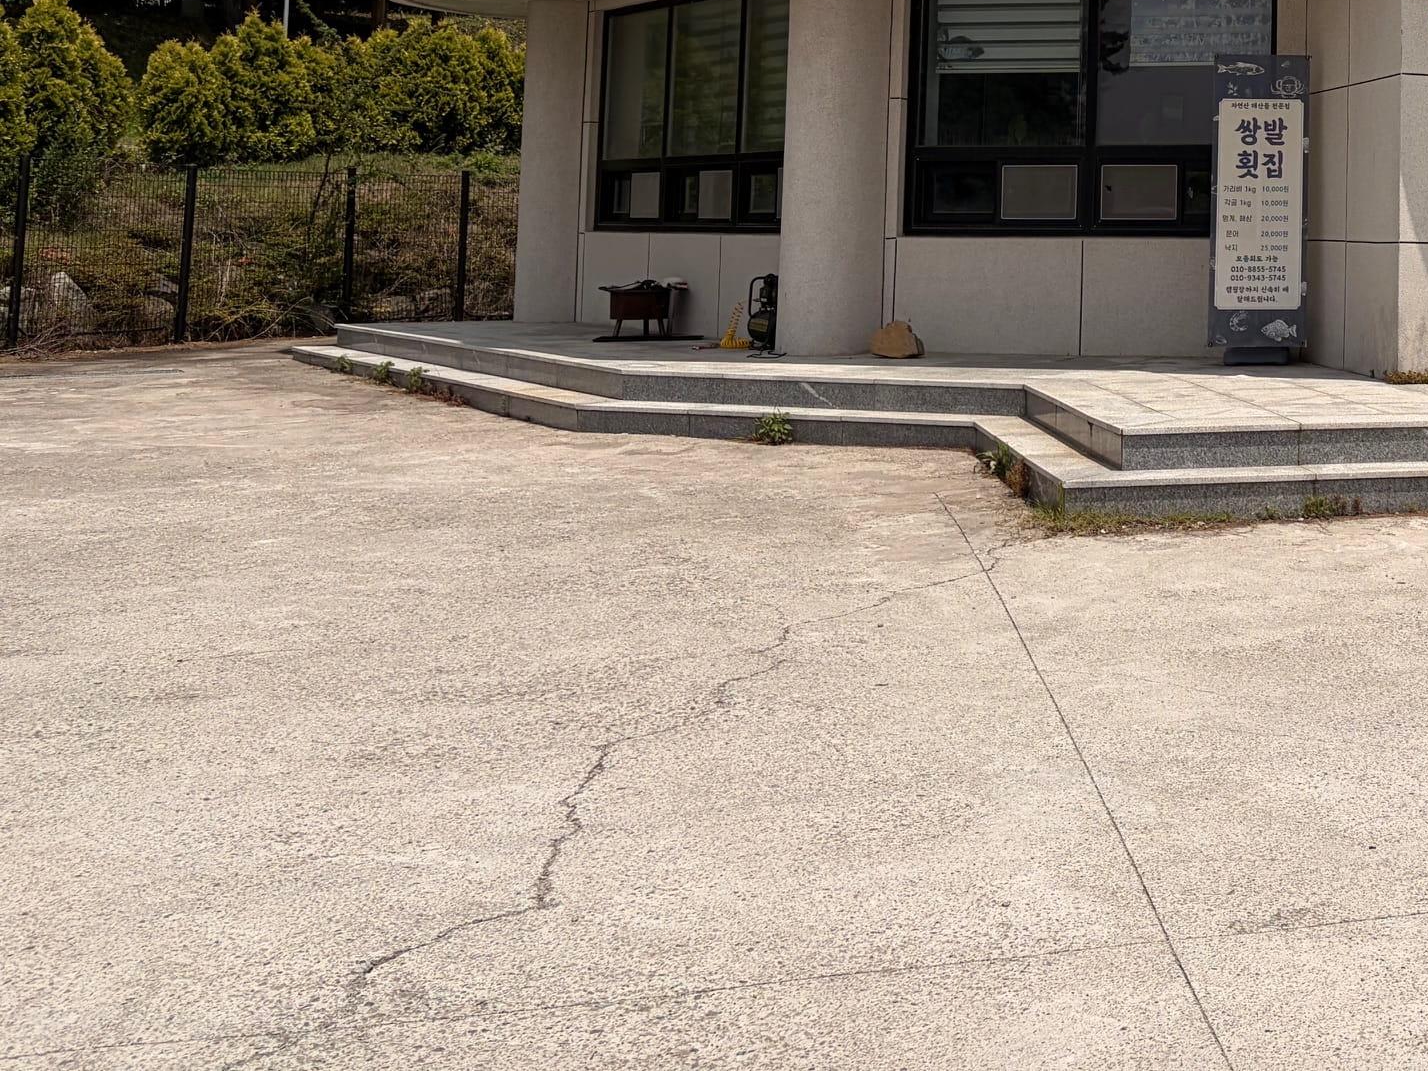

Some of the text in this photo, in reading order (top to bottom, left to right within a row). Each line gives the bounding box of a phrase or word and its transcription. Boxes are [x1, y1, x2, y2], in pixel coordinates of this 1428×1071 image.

[1235, 117, 1288, 146] 쌍발
[1235, 149, 1283, 179] 횟집
[1223, 185, 1289, 194] 가리비 1kg 10,000원
[1240, 199, 1252, 208] 1kg
[1239, 214, 1252, 223] 해삼
[1260, 215, 1289, 223] 20,000원
[1225, 230, 1289, 238] 문어 20,000원
[1225, 244, 1288, 252] 낙지 25,000원
[1265, 255, 1279, 263] 가능
[1230, 265, 1287, 273] 010-8855-5745
[1230, 274, 1287, 282] 010-9343-5745
[1226, 285, 1259, 294] 캠핑장까지
[1261, 285, 1280, 294] 신속히
